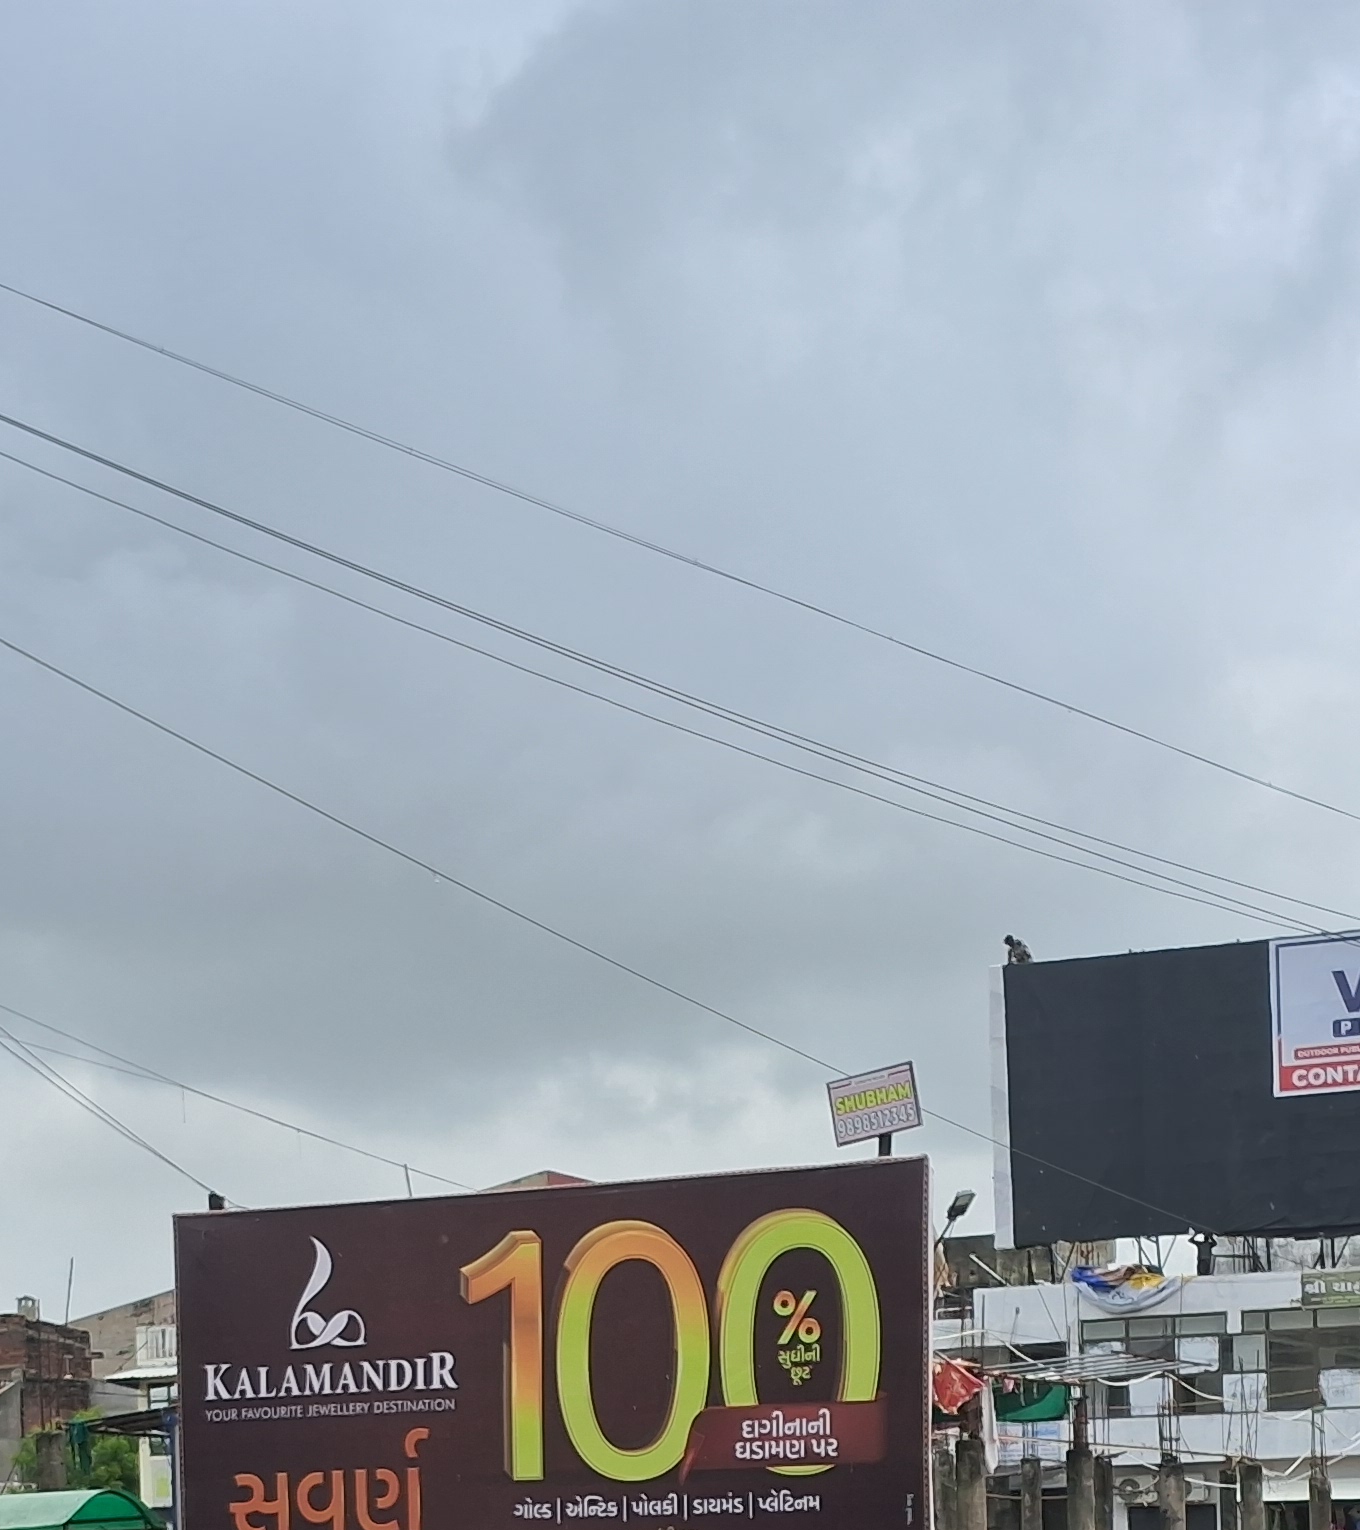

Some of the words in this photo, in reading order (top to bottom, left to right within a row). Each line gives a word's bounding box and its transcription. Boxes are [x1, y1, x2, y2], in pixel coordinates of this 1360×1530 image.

[1297, 1047, 1339, 1058] OUTDOOR
[835, 1083, 911, 1115] SHUBHAM
[837, 1102, 915, 1138] 9898512345
[459, 1207, 882, 1482] 100
[777, 1344, 821, 1369] સુધીની
[204, 1351, 459, 1400] KALAMANDIR
[790, 1366, 813, 1386] છૂટ
[205, 1408, 239, 1422] YOUR
[241, 1405, 303, 1420] FAVOURITE
[307, 1402, 370, 1417] JEWELLERY
[374, 1398, 456, 1414] DESTINATION
[741, 1408, 832, 1439] દાગીનાની
[734, 1439, 806, 1460] ઘડામણ
[811, 1438, 839, 1458] પર
[513, 1497, 553, 1519] ગોલ્ડ
[565, 1495, 619, 1518] એન્ટિક
[630, 1492, 678, 1516] પોલકી
[692, 1492, 744, 1515] ડાયમંડ
[756, 1489, 821, 1513] પ્લેટિનમ
